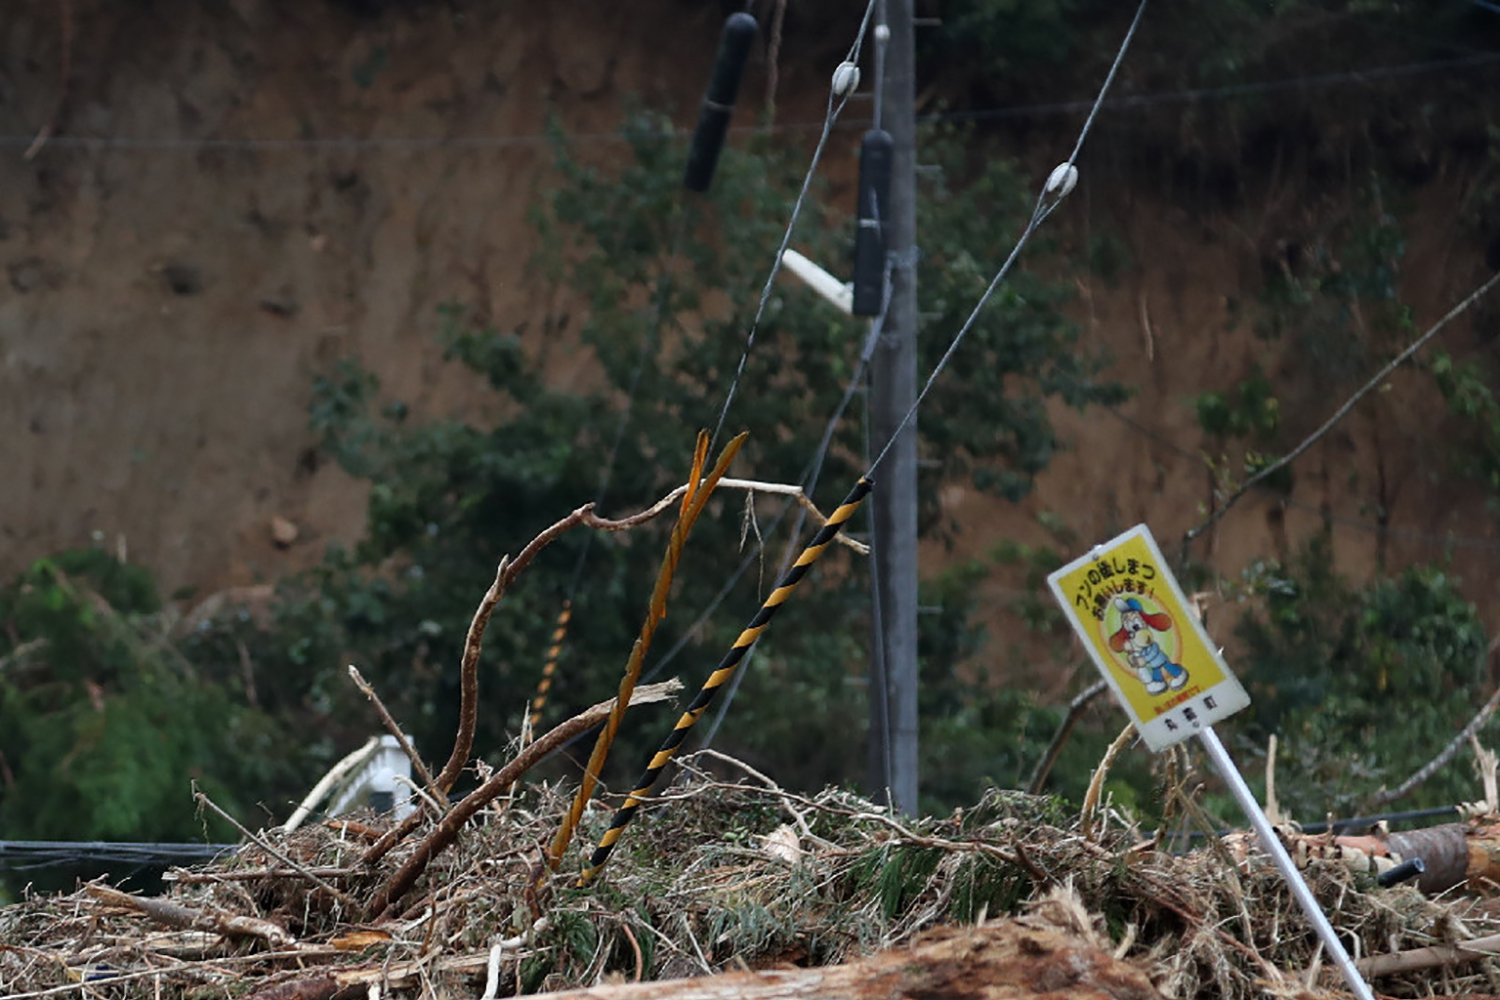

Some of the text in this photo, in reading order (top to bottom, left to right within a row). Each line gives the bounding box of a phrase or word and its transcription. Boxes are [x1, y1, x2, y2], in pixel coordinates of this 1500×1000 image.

[1076, 557, 1155, 610] フンの後しまつ
